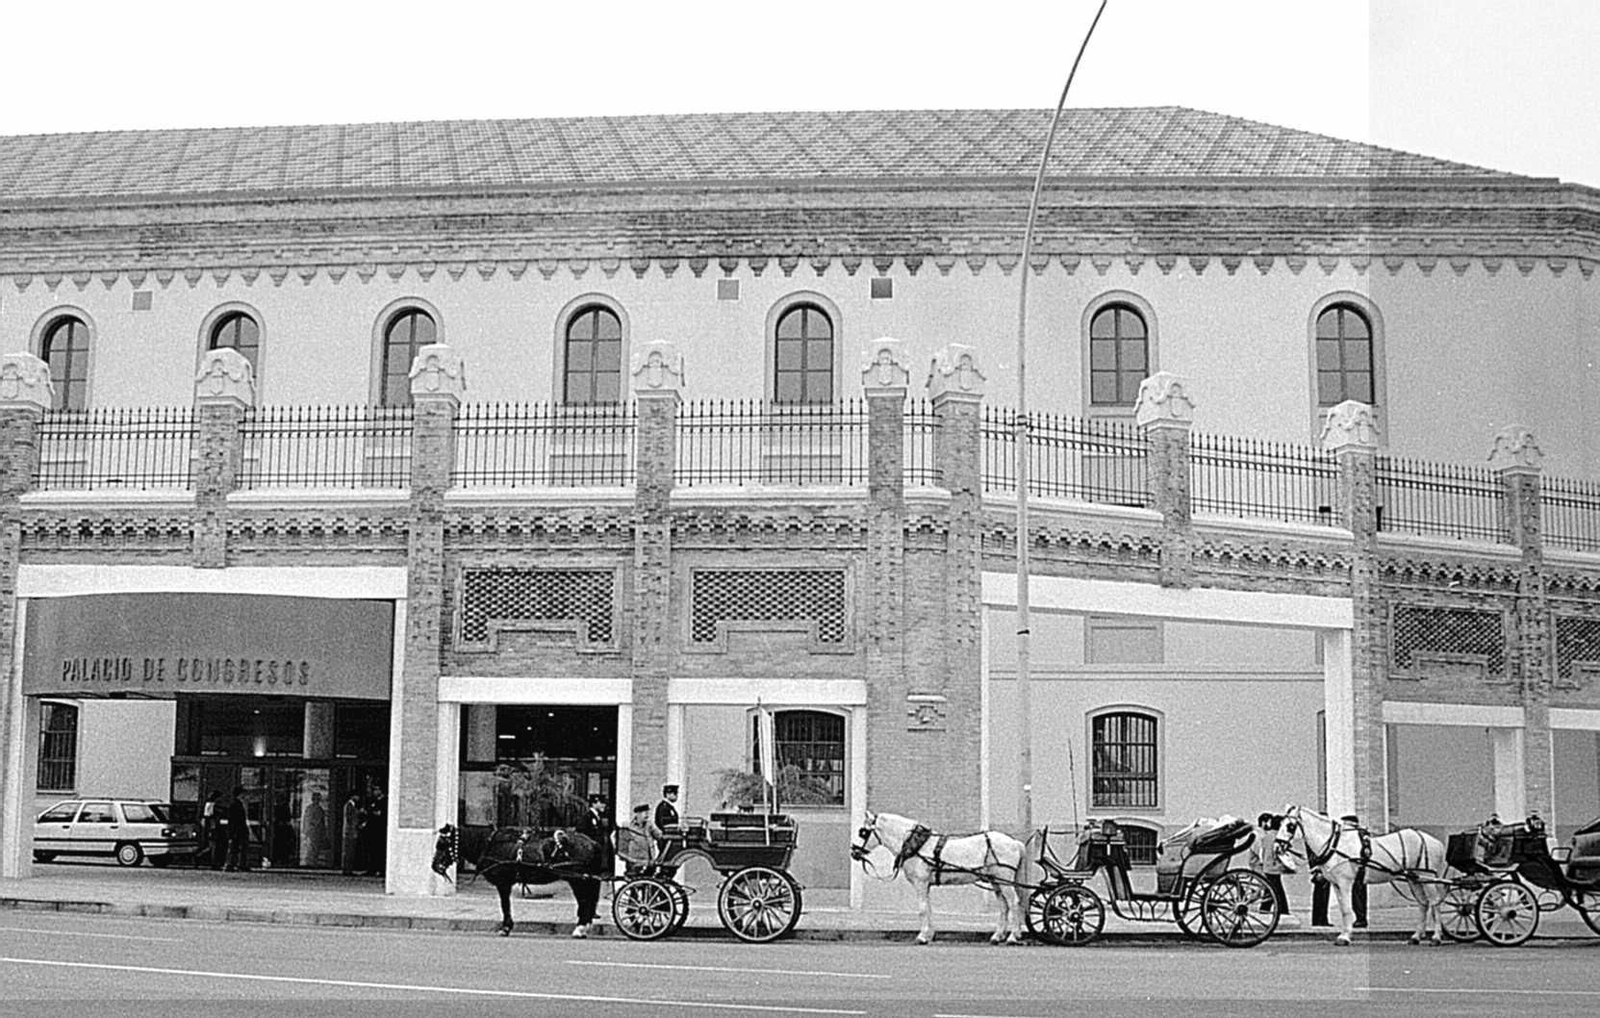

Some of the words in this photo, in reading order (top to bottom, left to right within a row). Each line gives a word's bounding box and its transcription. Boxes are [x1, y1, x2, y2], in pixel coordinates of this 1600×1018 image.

[62, 657, 132, 682] PALACIO
[143, 657, 165, 682] DE
[177, 657, 309, 686] CONGRESOS
